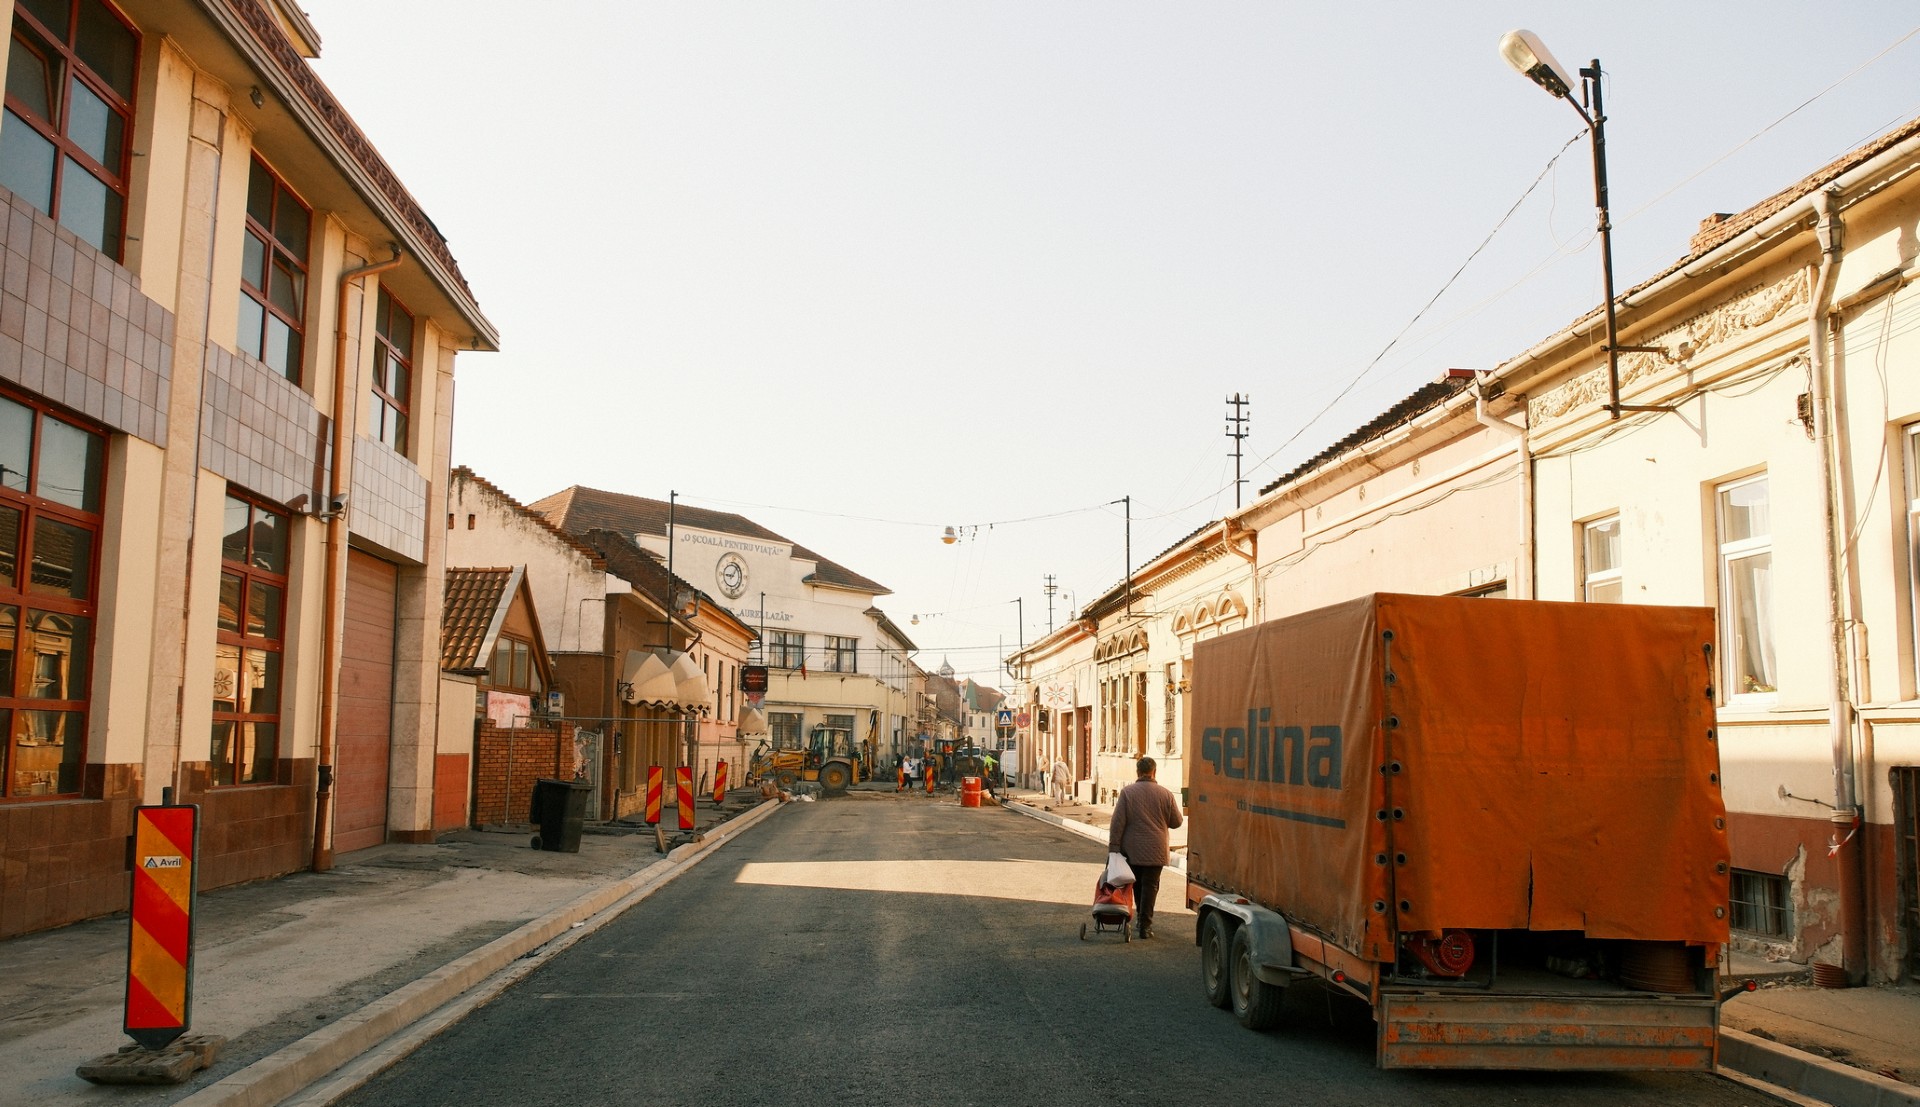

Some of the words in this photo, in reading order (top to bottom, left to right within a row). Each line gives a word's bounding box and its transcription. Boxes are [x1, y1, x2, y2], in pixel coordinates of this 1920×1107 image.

[692, 535, 724, 547] ȘCOALĂ
[724, 540, 754, 551] PENTRU
[1202, 707, 1342, 790] selina
[160, 858, 181, 866] Avril
